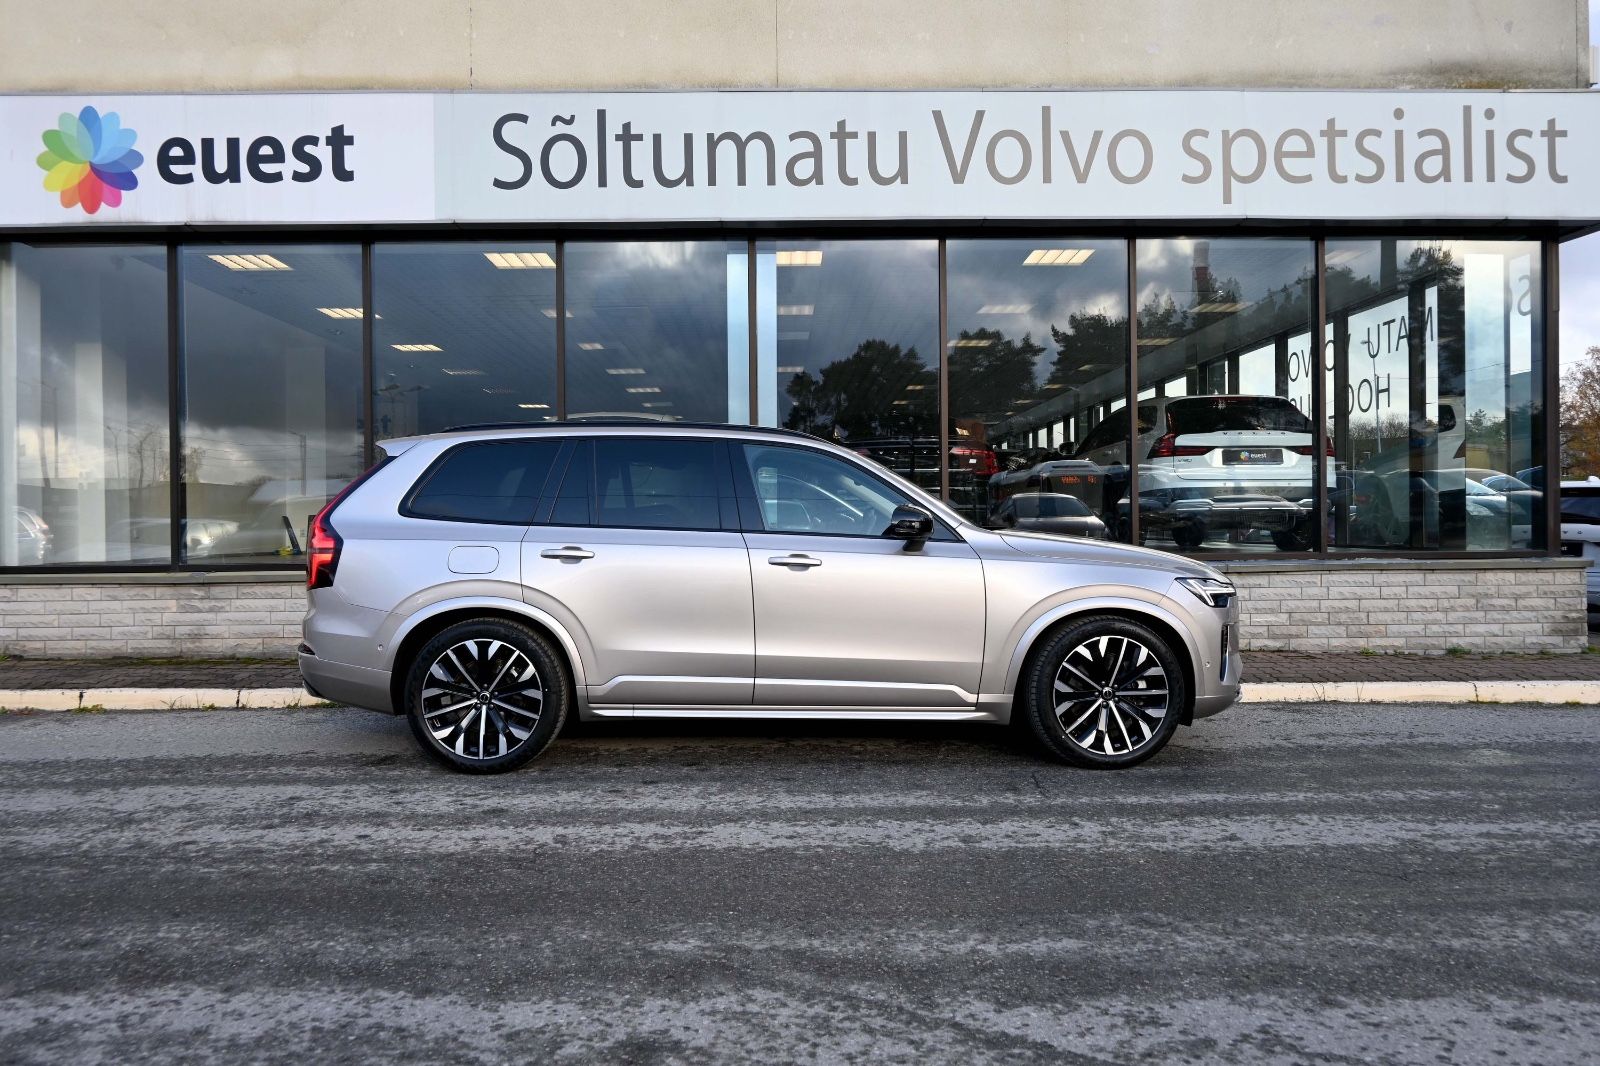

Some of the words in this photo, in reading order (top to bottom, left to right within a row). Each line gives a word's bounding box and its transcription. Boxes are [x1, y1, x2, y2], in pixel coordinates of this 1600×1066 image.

[156, 124, 354, 185] euest
[492, 109, 908, 190] Sõltumatu
[932, 105, 1154, 185] Volvo
[1181, 105, 1568, 205] spetsialist
